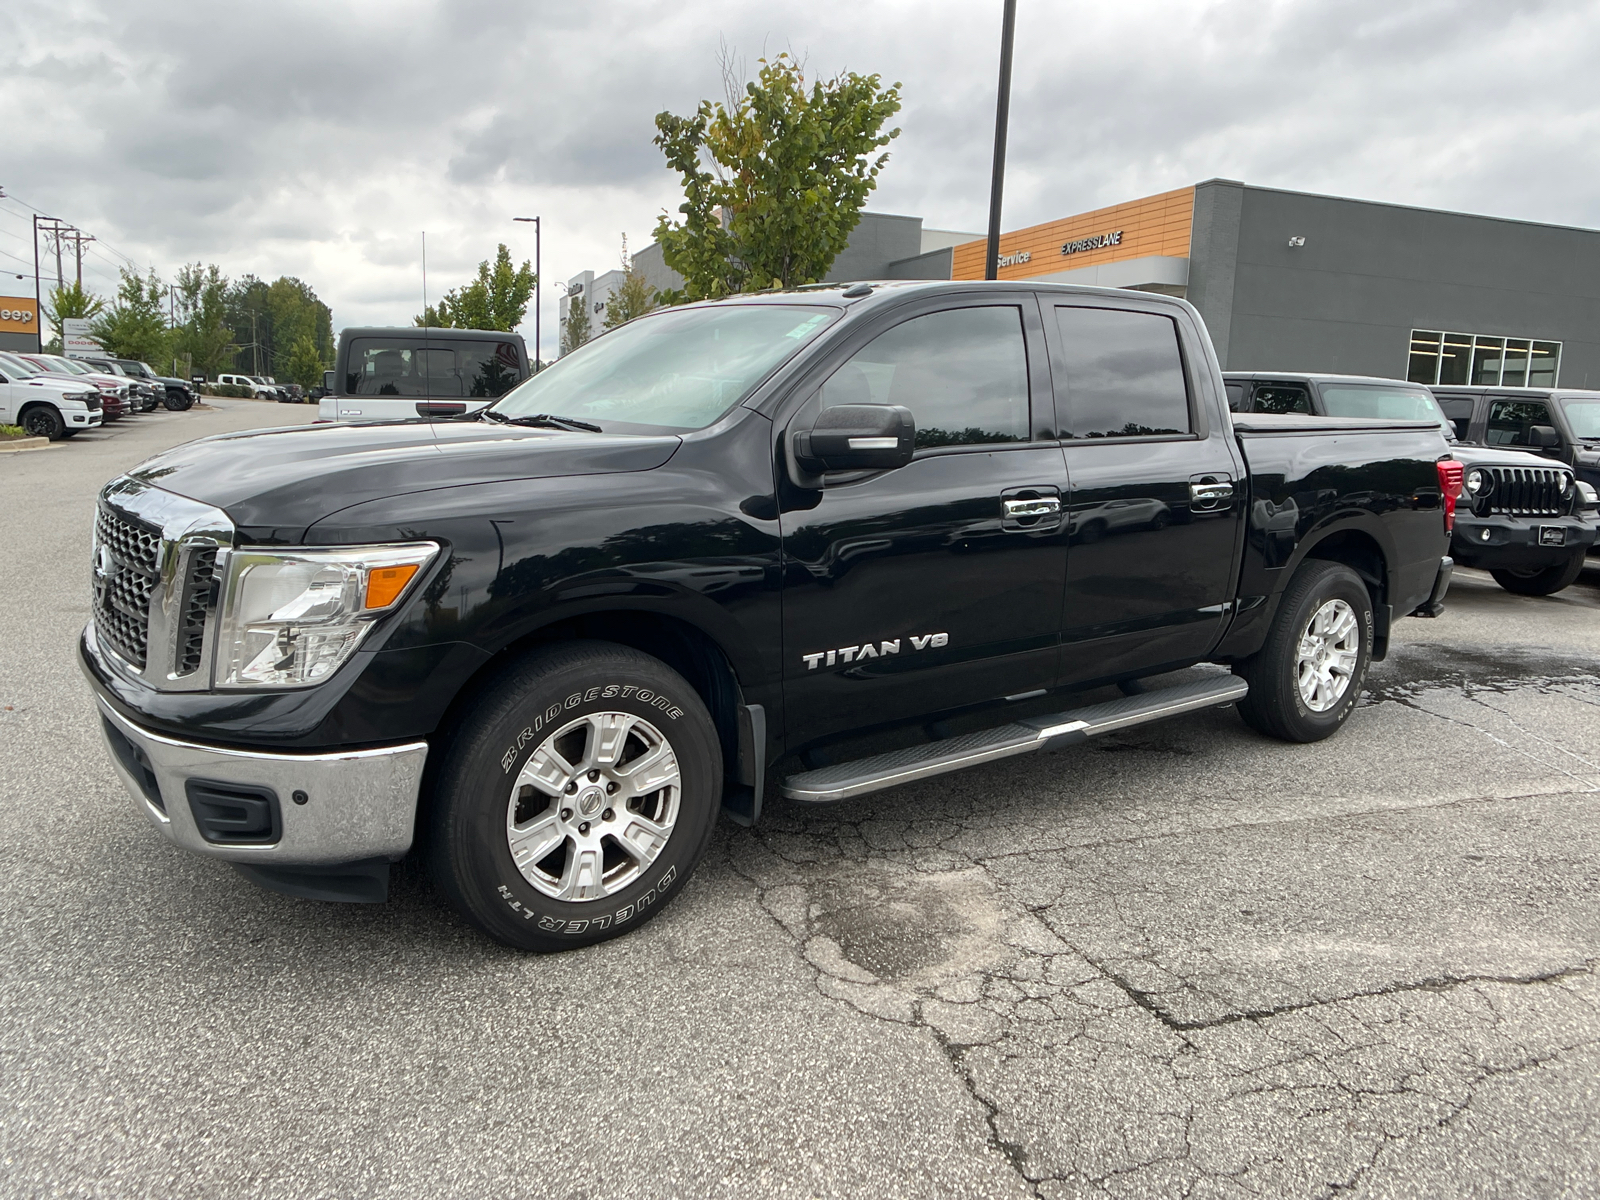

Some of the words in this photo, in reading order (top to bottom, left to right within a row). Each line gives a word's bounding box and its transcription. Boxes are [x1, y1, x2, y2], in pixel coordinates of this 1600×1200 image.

[0, 309, 33, 323] eep
[802, 638, 901, 670] TITAN
[909, 632, 949, 651] V8
[500, 684, 684, 775] BRIDGESTONE
[537, 864, 678, 935] DUELER
